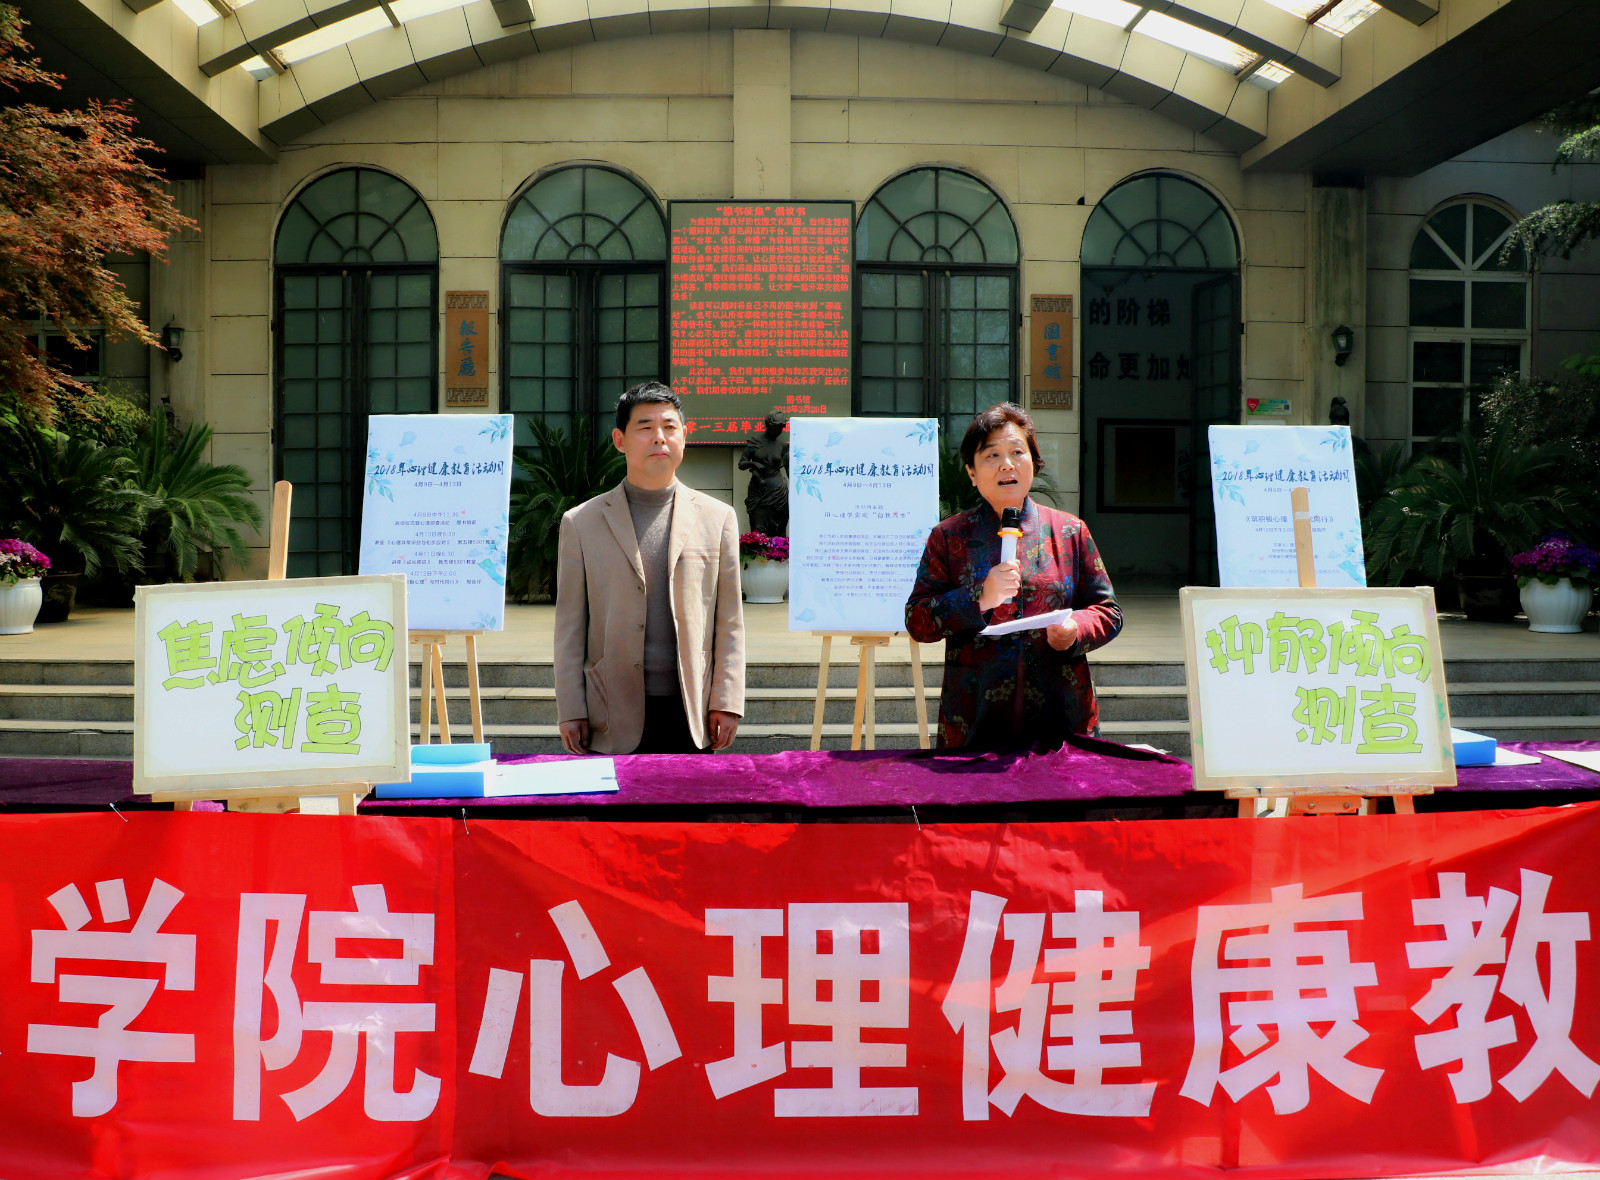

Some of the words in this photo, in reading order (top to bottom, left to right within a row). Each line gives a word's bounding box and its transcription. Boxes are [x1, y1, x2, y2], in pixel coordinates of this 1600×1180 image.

[1089, 297, 1171, 327] 的阶梯
[374, 461, 504, 476] 2018年心理健康教育活动周
[800, 462, 934, 477] 2018年心理健康教育活动周
[1222, 469, 1350, 483] 2018年心理健康教育活动周
[156, 603, 395, 691] 焦虑倾向
[1205, 609, 1432, 683] 抑郁倾向
[234, 683, 362, 755] 测查
[1292, 683, 1423, 754] 测查
[26, 868, 1600, 1122] 学院心理健康教
